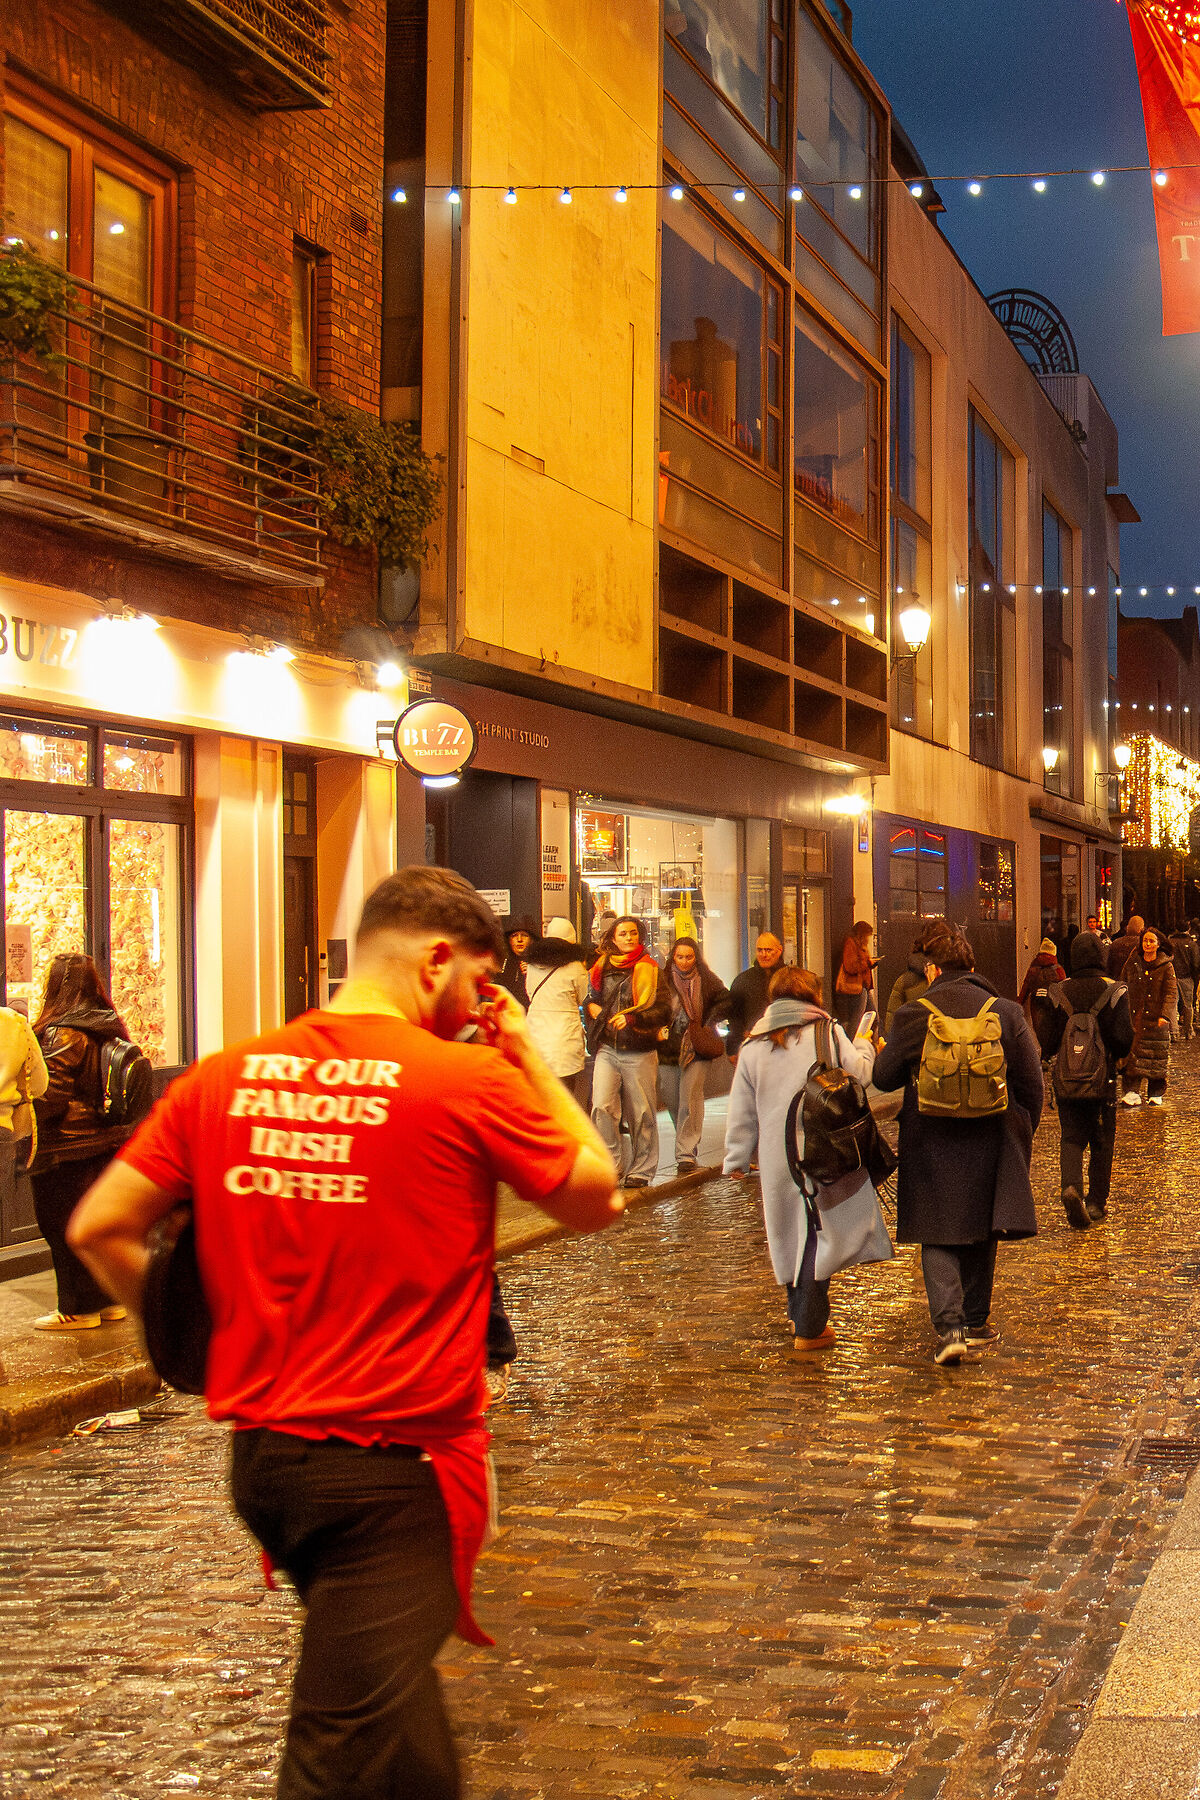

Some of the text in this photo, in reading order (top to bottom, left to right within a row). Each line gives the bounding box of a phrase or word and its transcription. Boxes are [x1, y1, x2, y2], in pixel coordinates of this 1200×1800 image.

[403, 722, 466, 746] BUZZ
[491, 725, 516, 742] PRINT
[519, 730, 550, 749] STUDIO
[445, 748, 460, 756] BAR
[543, 845, 559, 854] LEARN
[543, 882, 565, 891] COLLECT
[241, 1053, 403, 1087] TRY OUR
[228, 1088, 391, 1125] FAMOUS
[249, 1126, 355, 1163] IRISH
[223, 1165, 369, 1203] COFFEE
